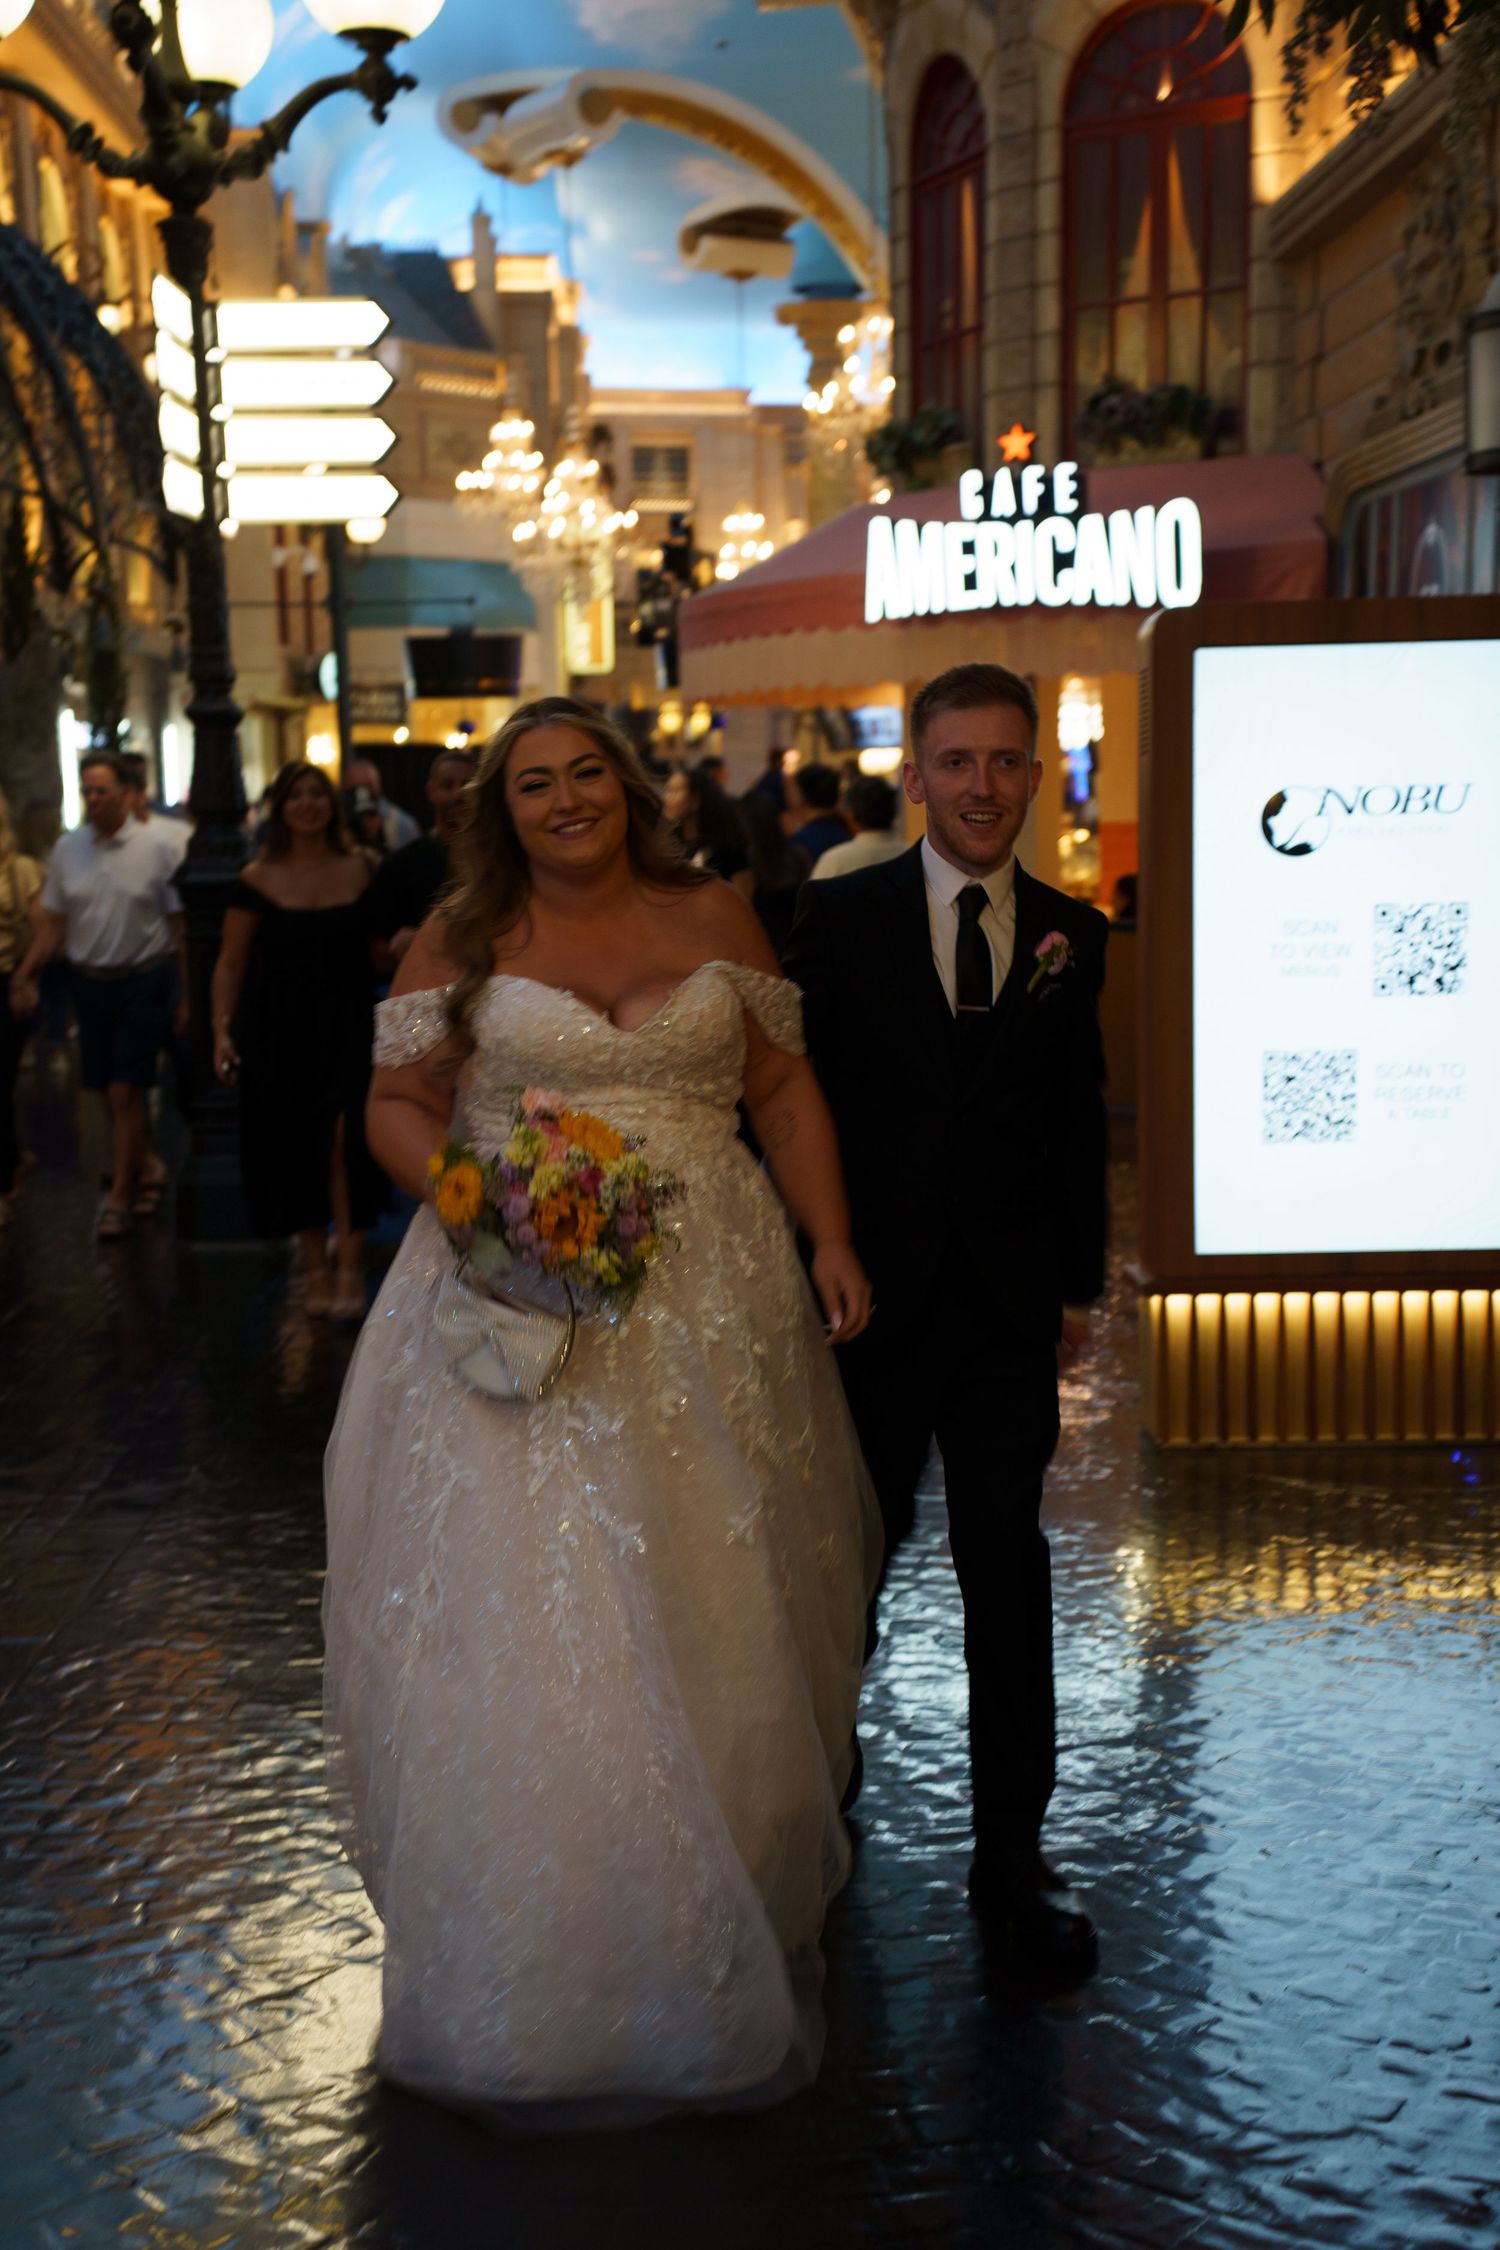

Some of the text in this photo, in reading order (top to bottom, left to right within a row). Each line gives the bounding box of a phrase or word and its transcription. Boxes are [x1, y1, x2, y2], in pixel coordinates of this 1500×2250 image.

[960, 461, 1078, 520] CAFE
[865, 497, 1202, 624] AMERICANO
[1316, 783, 1474, 816] NOBU
[1281, 919, 1339, 936] SCAN
[1269, 943, 1353, 959] TO VIEW
[1376, 1061, 1467, 1079] SCAN TO
[1375, 1086, 1467, 1102] RESERVE
